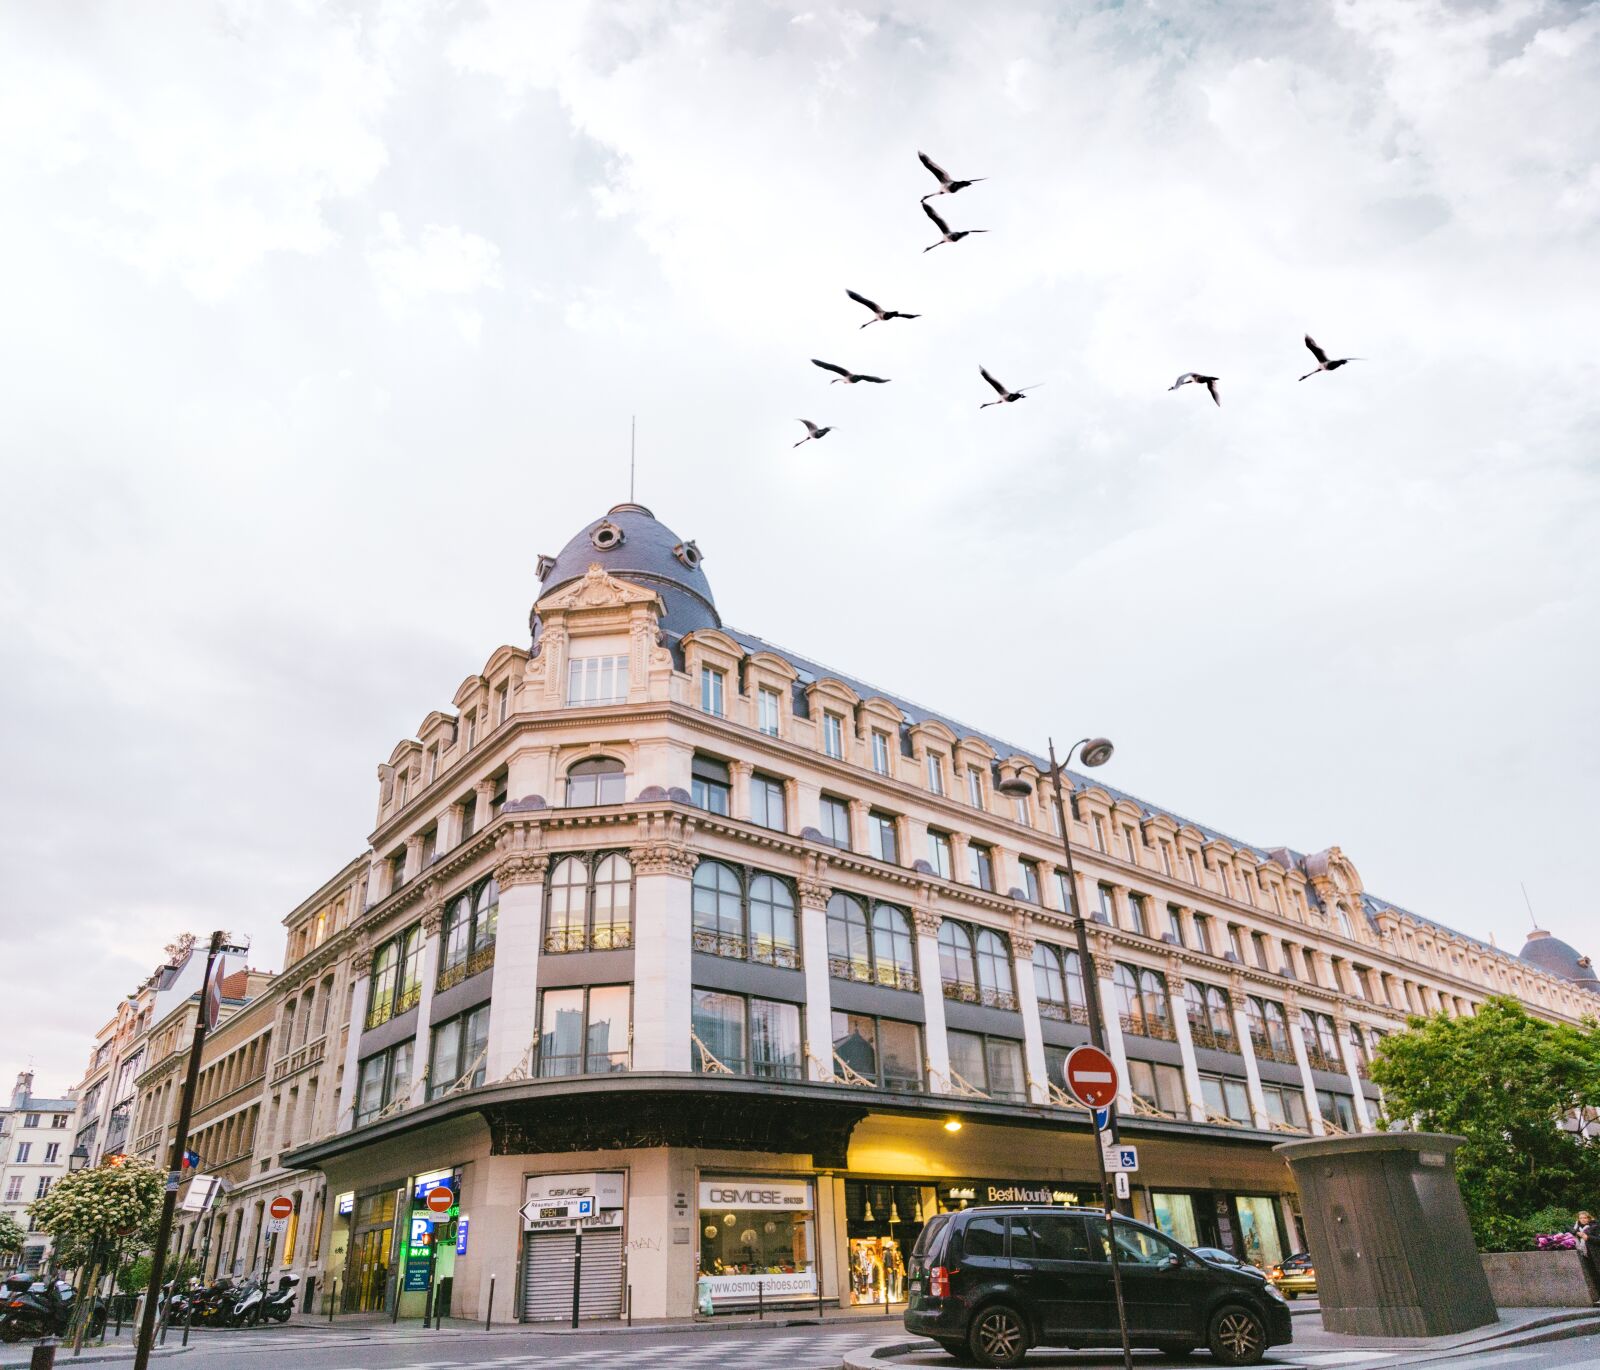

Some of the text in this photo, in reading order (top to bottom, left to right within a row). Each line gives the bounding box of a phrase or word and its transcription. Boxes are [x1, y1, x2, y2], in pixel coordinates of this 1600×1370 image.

[710, 1189, 781, 1204] OSMOSE
[541, 1208, 557, 1217] OPEN
[411, 1220, 427, 1240] P
[410, 1248, 430, 1256] 24/24
